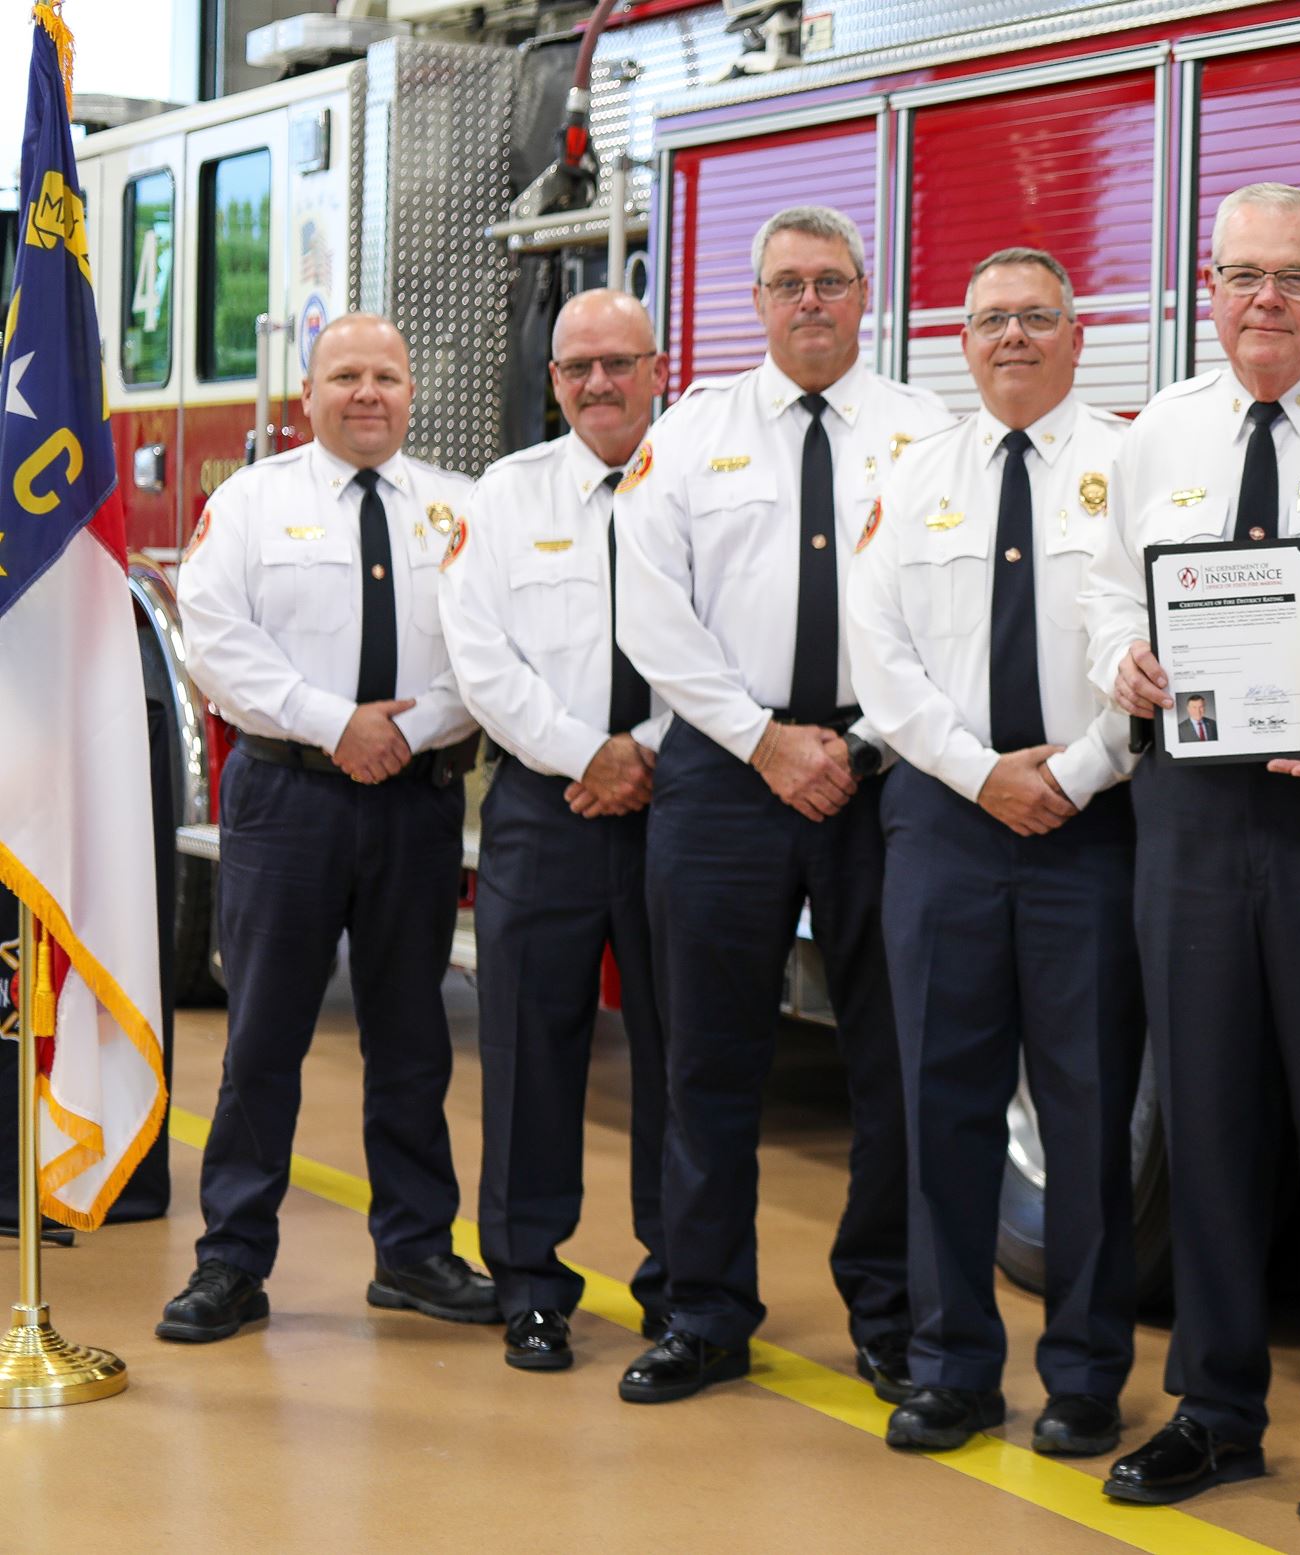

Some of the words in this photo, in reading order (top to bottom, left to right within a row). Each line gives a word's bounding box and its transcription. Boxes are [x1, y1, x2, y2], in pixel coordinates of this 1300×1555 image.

[132, 228, 160, 333] 4
[13, 426, 84, 516] C
[1205, 568, 1283, 584] INSURANCE
[1216, 563, 1259, 572] DEPARTMENT
